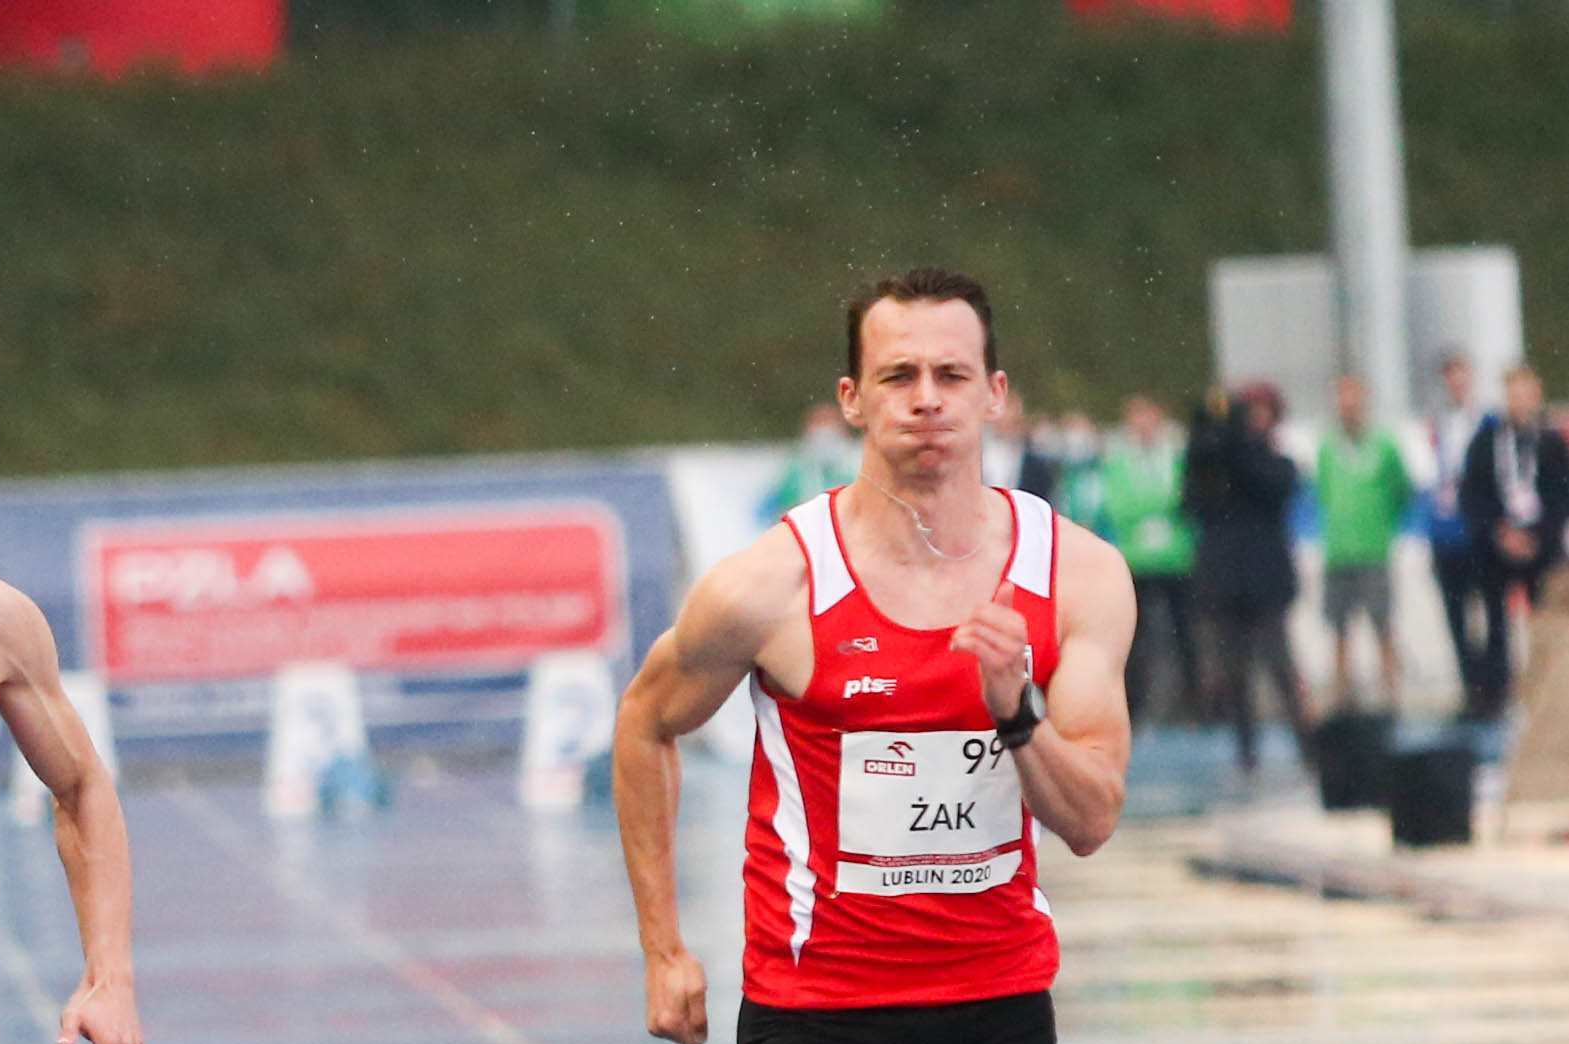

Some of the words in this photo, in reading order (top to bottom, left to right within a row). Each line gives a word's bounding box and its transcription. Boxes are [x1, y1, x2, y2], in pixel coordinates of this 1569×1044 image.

[866, 761, 914, 774] ORLEN
[909, 796, 976, 832] ŻAK
[882, 869, 944, 887] LUBLIN
[951, 865, 991, 884] 2020
